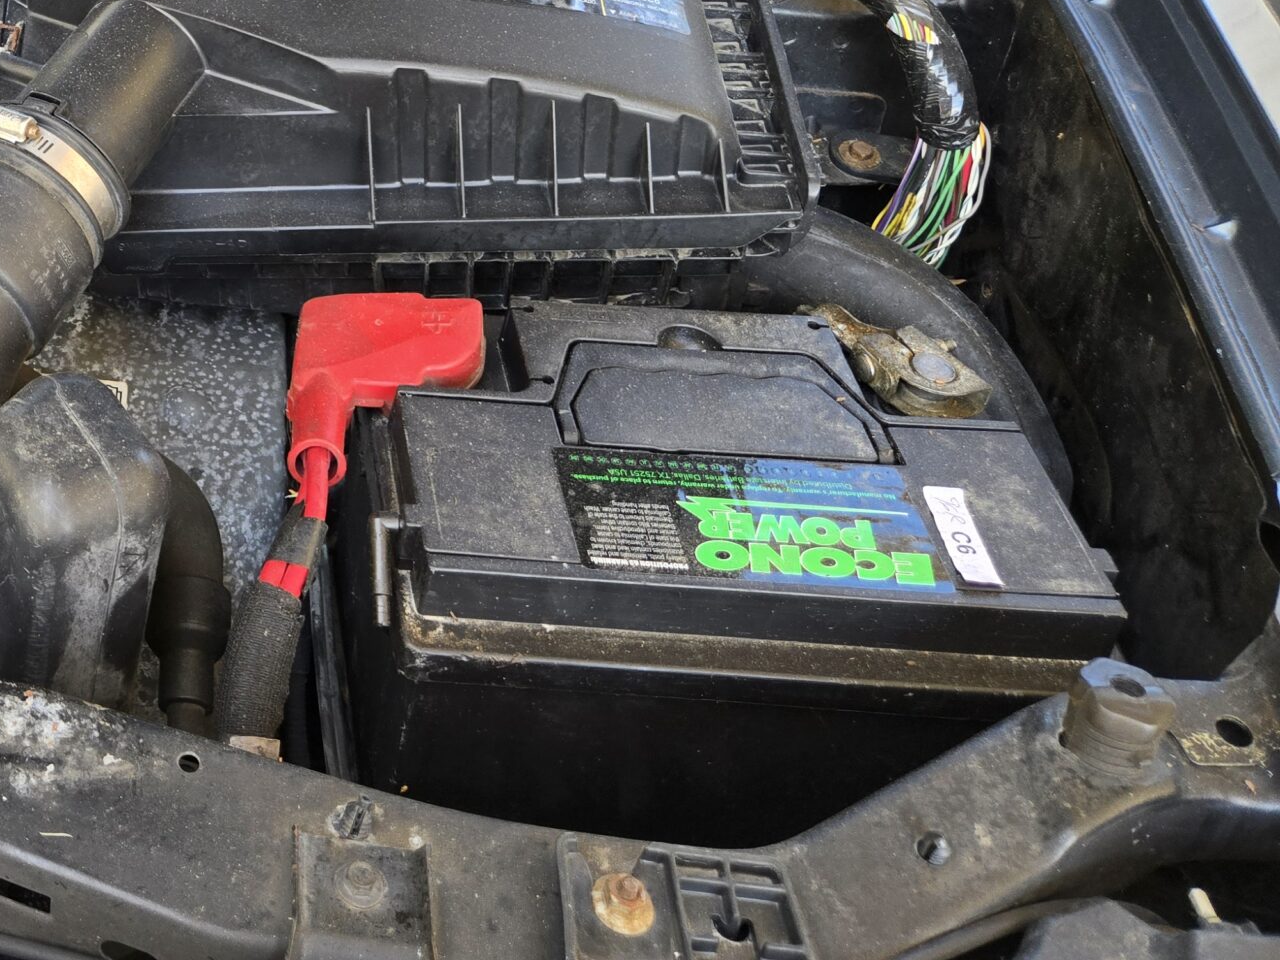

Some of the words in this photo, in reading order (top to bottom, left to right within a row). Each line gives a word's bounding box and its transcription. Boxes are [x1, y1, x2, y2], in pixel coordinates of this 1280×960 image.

[570, 473, 609, 481] purchase.
[672, 472, 702, 480] Dallas,
[677, 480, 712, 488] warranty,
[789, 477, 801, 486] by
[803, 479, 852, 490] Distributed
[772, 486, 784, 494] To
[823, 490, 882, 499] manufacturer's
[684, 504, 876, 550] POWER
[951, 531, 976, 554] C6
[695, 540, 936, 586] ECONO
